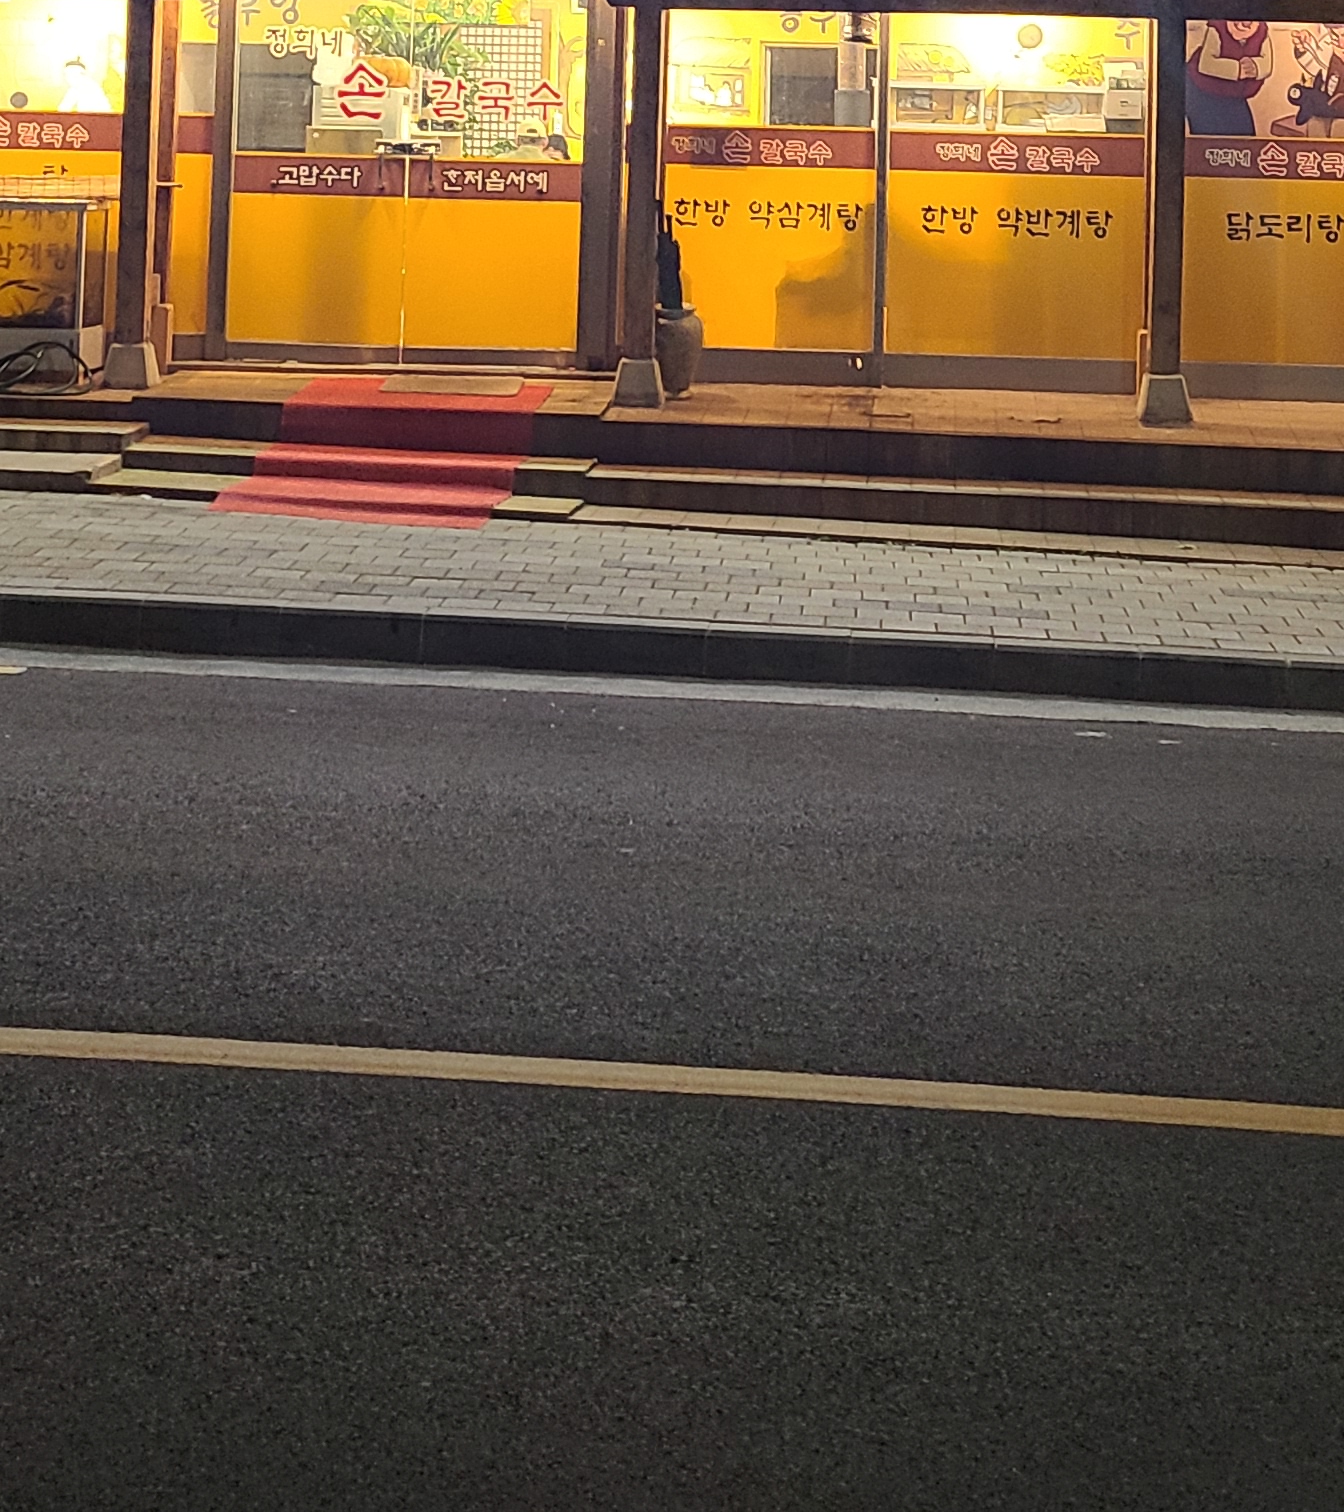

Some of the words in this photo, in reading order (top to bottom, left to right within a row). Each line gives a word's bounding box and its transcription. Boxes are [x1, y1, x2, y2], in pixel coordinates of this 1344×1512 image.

[266, 28, 343, 57] 정희네
[430, 79, 564, 121] 칼국수
[17, 122, 90, 148] 칼국수
[759, 139, 832, 165] 칼국수
[936, 143, 981, 163] 정희네
[1025, 146, 1100, 172] 칼국수
[1205, 147, 1251, 168] 정희네
[278, 165, 362, 188] 고맙수다
[674, 198, 731, 228] 한방
[748, 199, 864, 232] 약삼계탕
[921, 204, 979, 236] 한방
[996, 206, 1114, 239] 약반계탕
